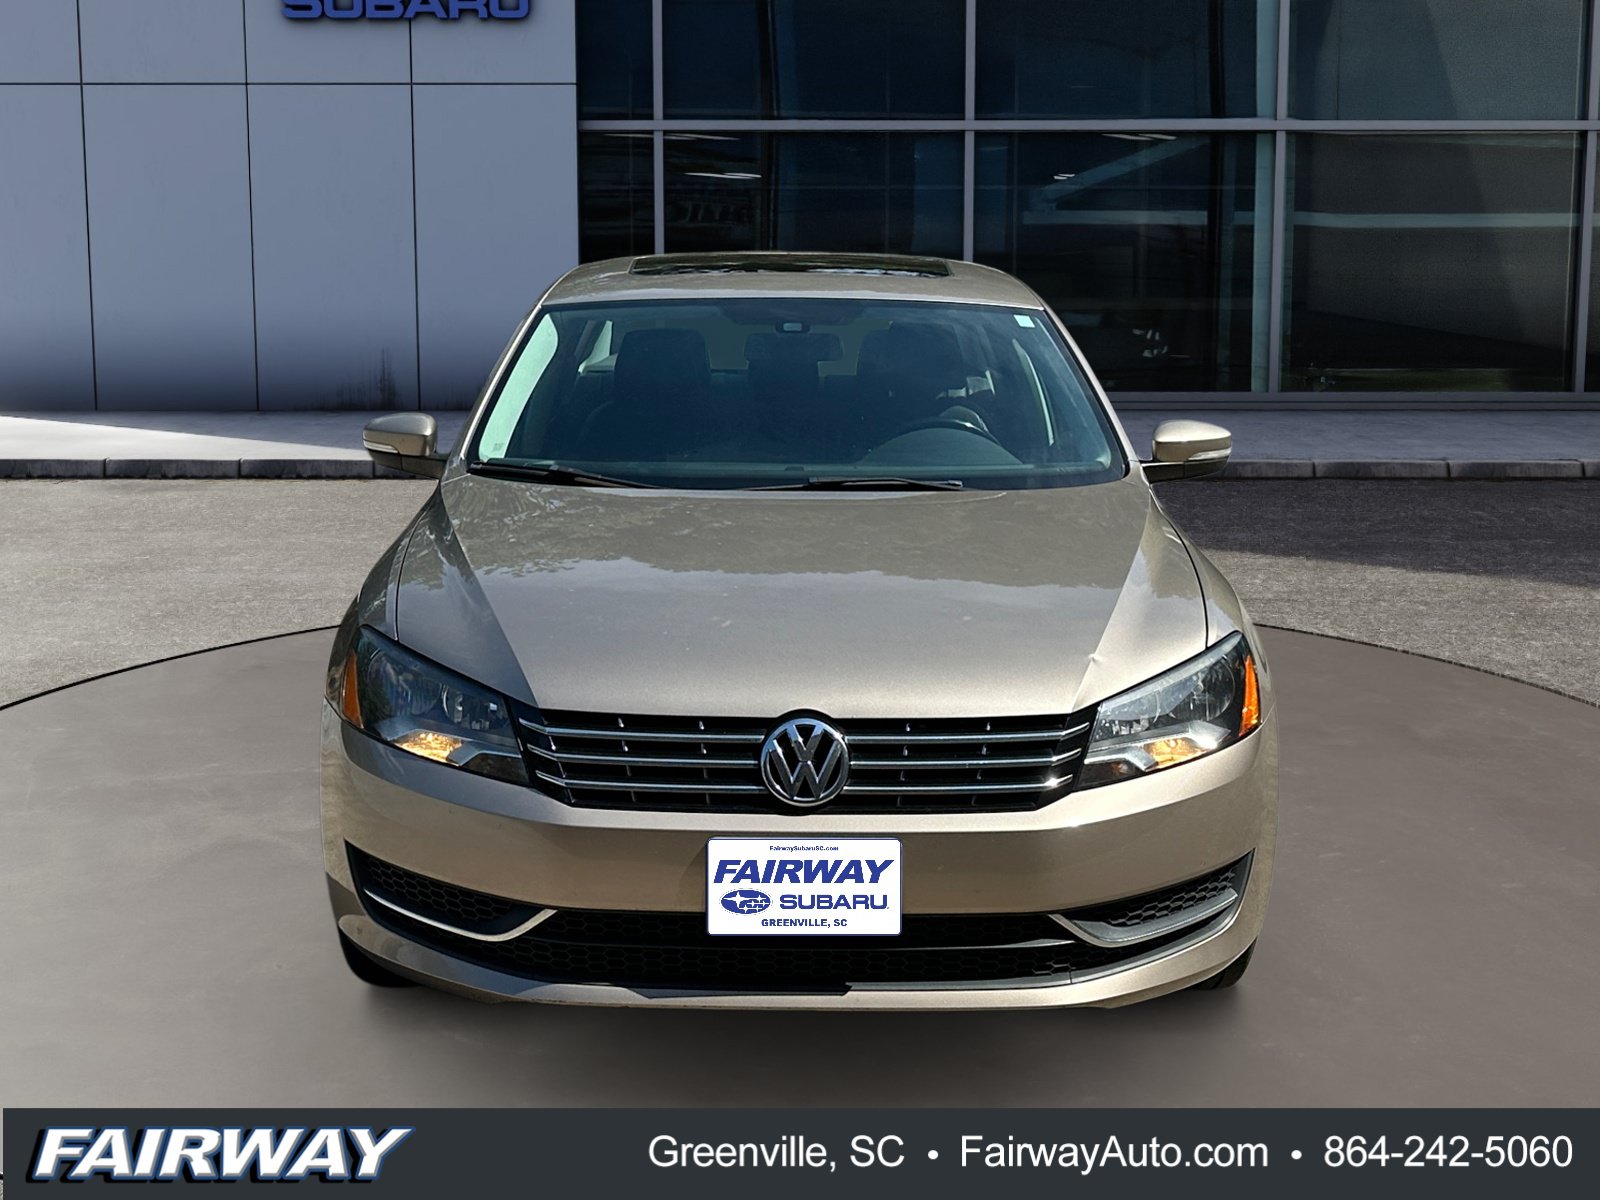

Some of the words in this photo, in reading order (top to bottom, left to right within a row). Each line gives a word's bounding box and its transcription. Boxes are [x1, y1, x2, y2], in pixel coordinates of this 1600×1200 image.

[769, 845, 839, 853] FairwaySubaruSC.com
[714, 860, 894, 883] FAIRWAY
[780, 895, 888, 909] SUBARU
[762, 919, 830, 928] GREENVILLE,
